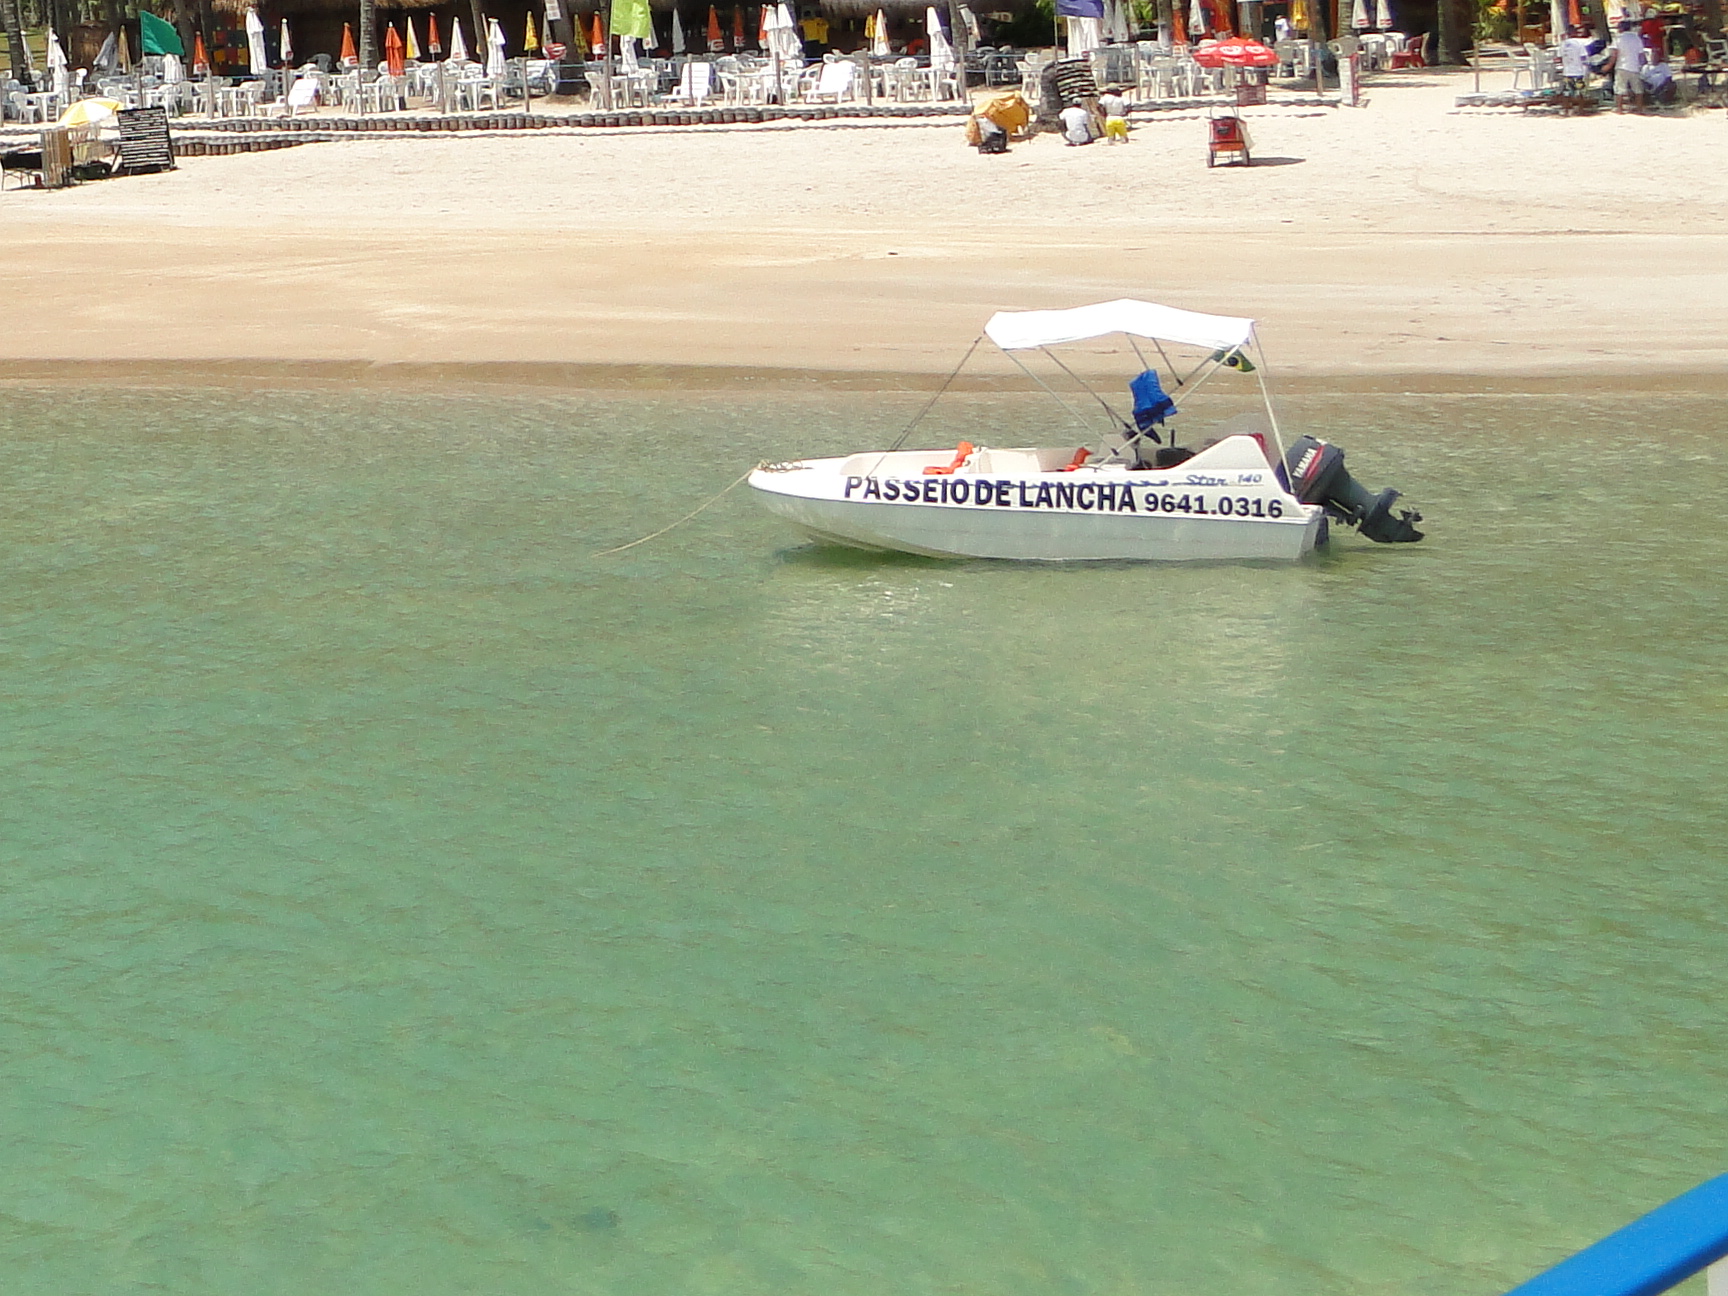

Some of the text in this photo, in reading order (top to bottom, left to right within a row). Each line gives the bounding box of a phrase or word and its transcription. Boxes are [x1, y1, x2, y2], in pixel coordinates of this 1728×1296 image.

[844, 476, 1283, 518] PASSEIO DE LANCHA 9641.0316
